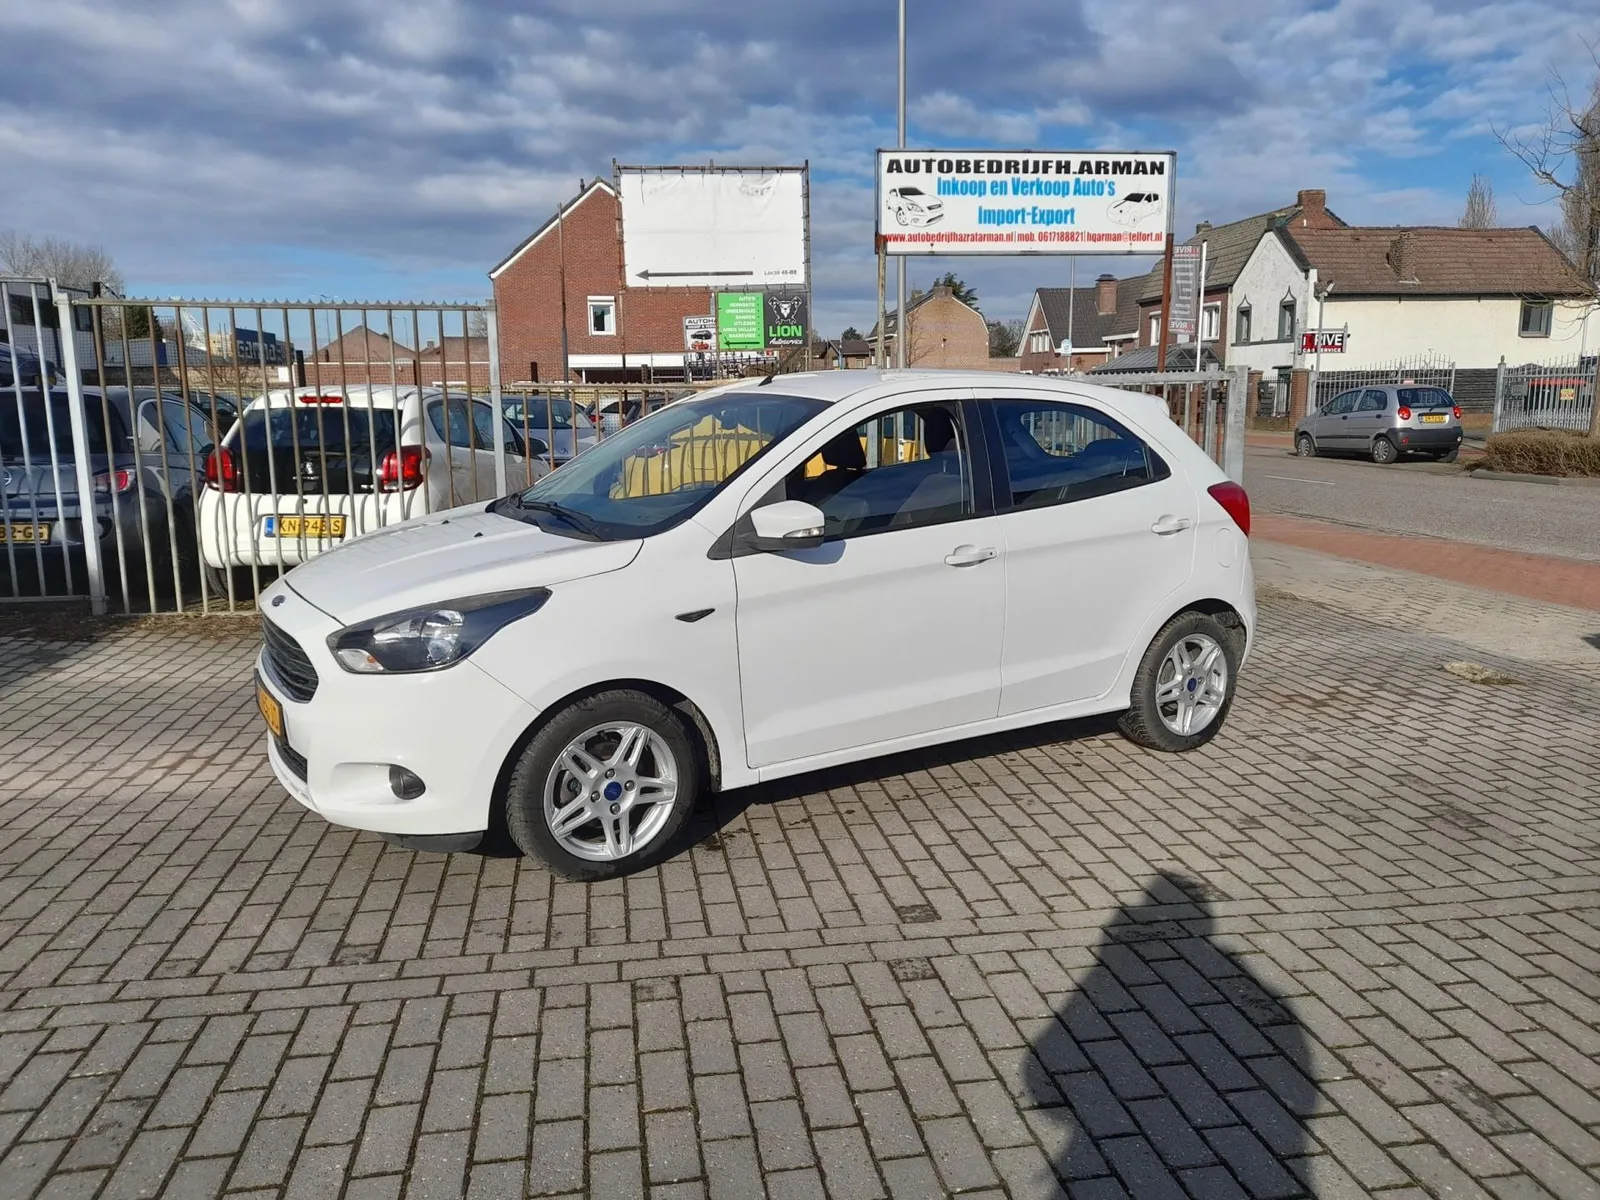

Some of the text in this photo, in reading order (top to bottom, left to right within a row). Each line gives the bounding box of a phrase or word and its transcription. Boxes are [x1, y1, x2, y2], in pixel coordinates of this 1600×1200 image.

[937, 177, 1116, 198] Inkoop en Verkoop Auto's
[978, 206, 1075, 226] Import-Export
[1017, 232, 1036, 242] mob.
[768, 325, 802, 337] LION
